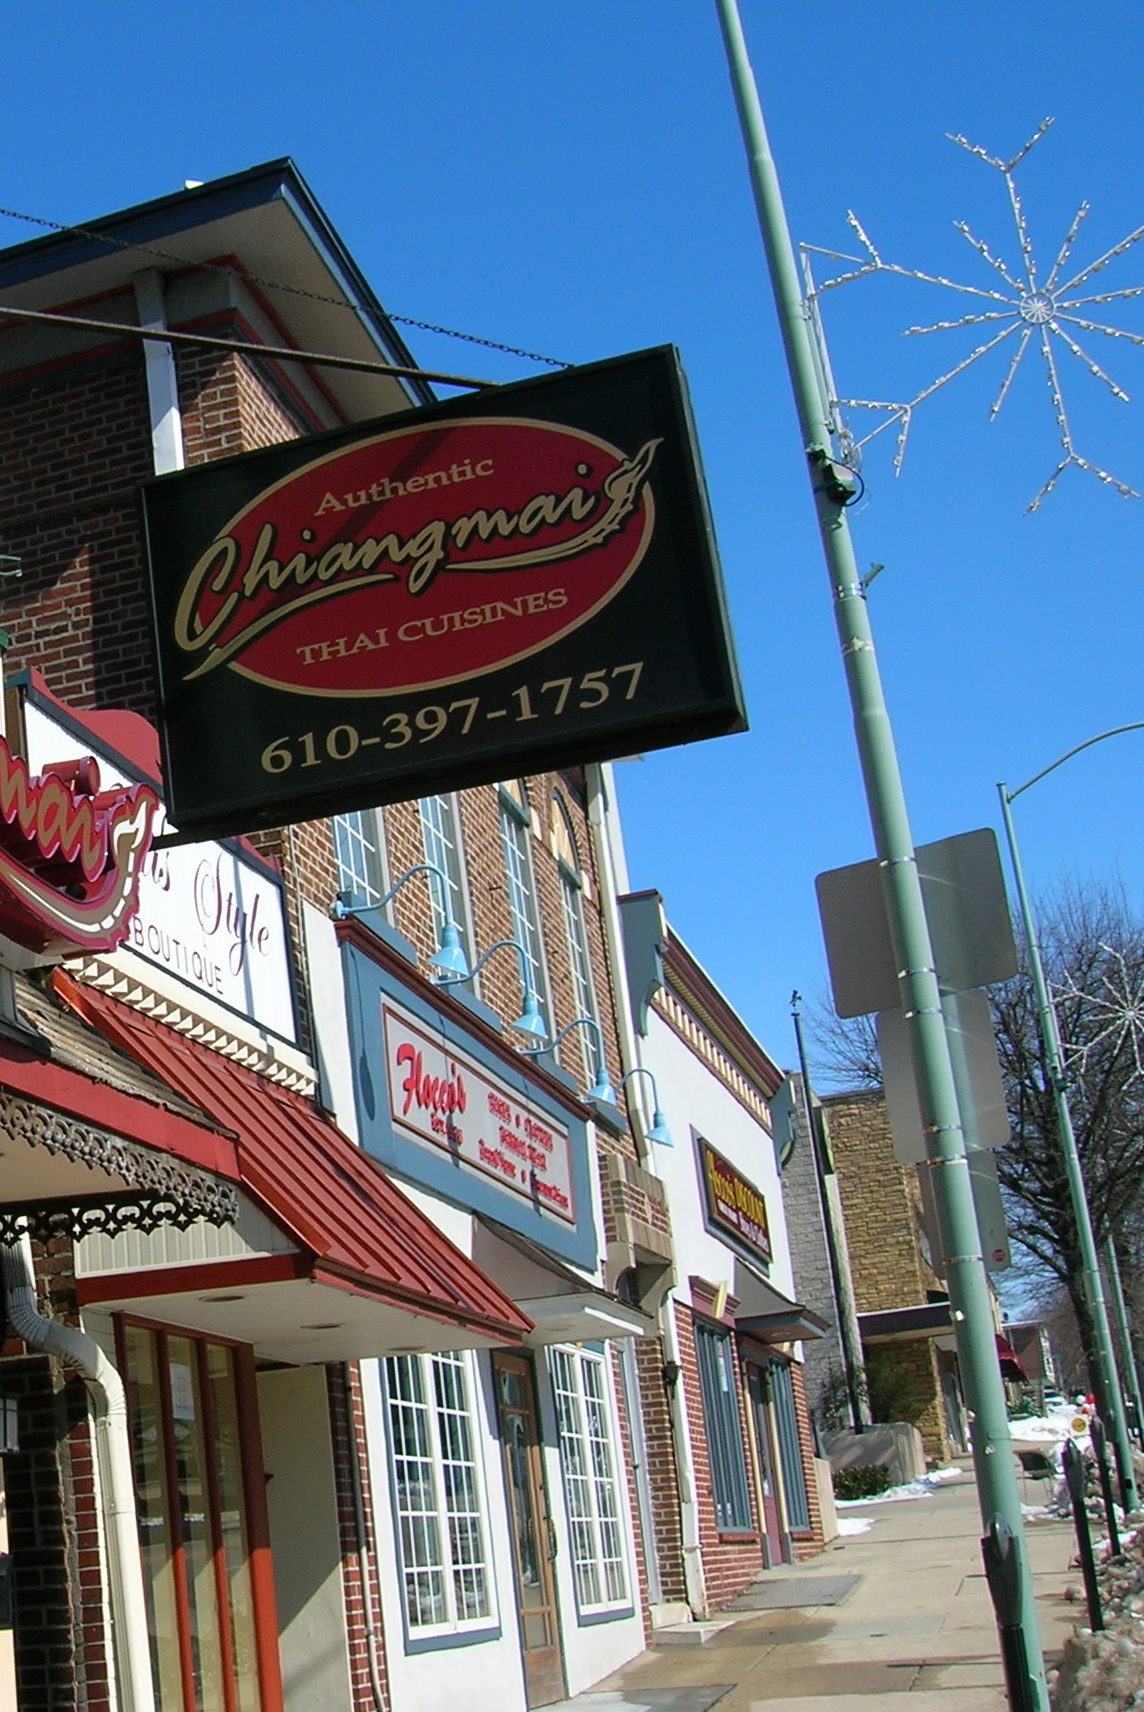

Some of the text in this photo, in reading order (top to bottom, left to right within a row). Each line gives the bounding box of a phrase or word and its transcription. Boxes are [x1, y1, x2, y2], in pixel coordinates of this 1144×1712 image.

[314, 456, 494, 516] Authentic
[174, 463, 598, 652] Chiangmai
[296, 588, 569, 665] THAI CUISINES
[261, 662, 645, 775] 610-397-1757
[133, 917, 224, 995] BOUTIQUE
[194, 851, 271, 977] Style
